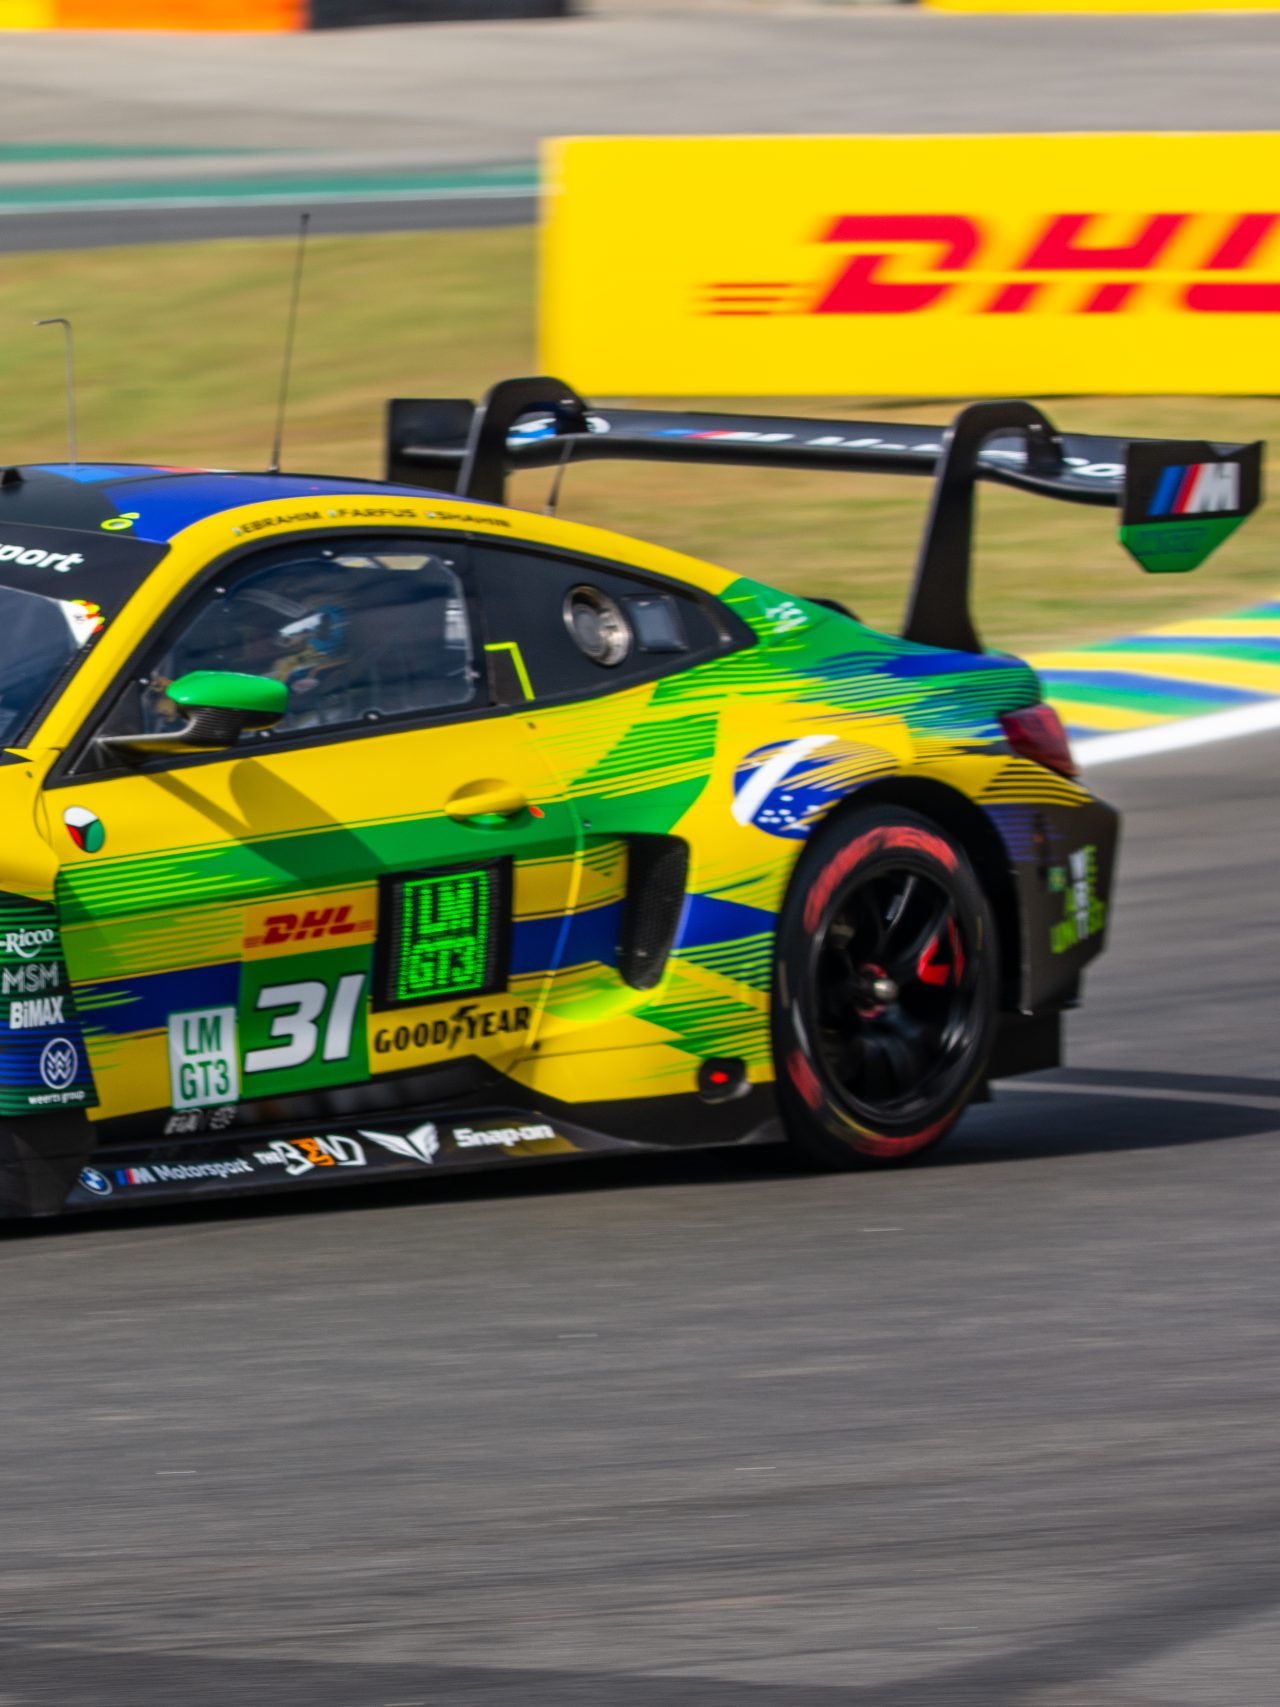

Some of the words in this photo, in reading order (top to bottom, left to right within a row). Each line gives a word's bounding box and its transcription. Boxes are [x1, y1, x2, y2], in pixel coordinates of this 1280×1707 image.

[810, 212, 1280, 315] DHL
[1182, 462, 1240, 514] M
[240, 510, 322, 533] EBRAHIM
[337, 508, 418, 518] FARFUS
[263, 905, 354, 945] DHL
[419, 882, 476, 934] LM
[2, 962, 60, 995] MSM
[408, 936, 477, 990] GT3
[9, 995, 66, 1030] BiMAX
[243, 972, 367, 1074] 31
[374, 1004, 533, 1054] GOODYEAR
[183, 1015, 222, 1057] LM
[179, 1058, 230, 1101] GT3
[452, 1124, 556, 1148] Snap-on
[155, 1157, 254, 1182] Motorsport
